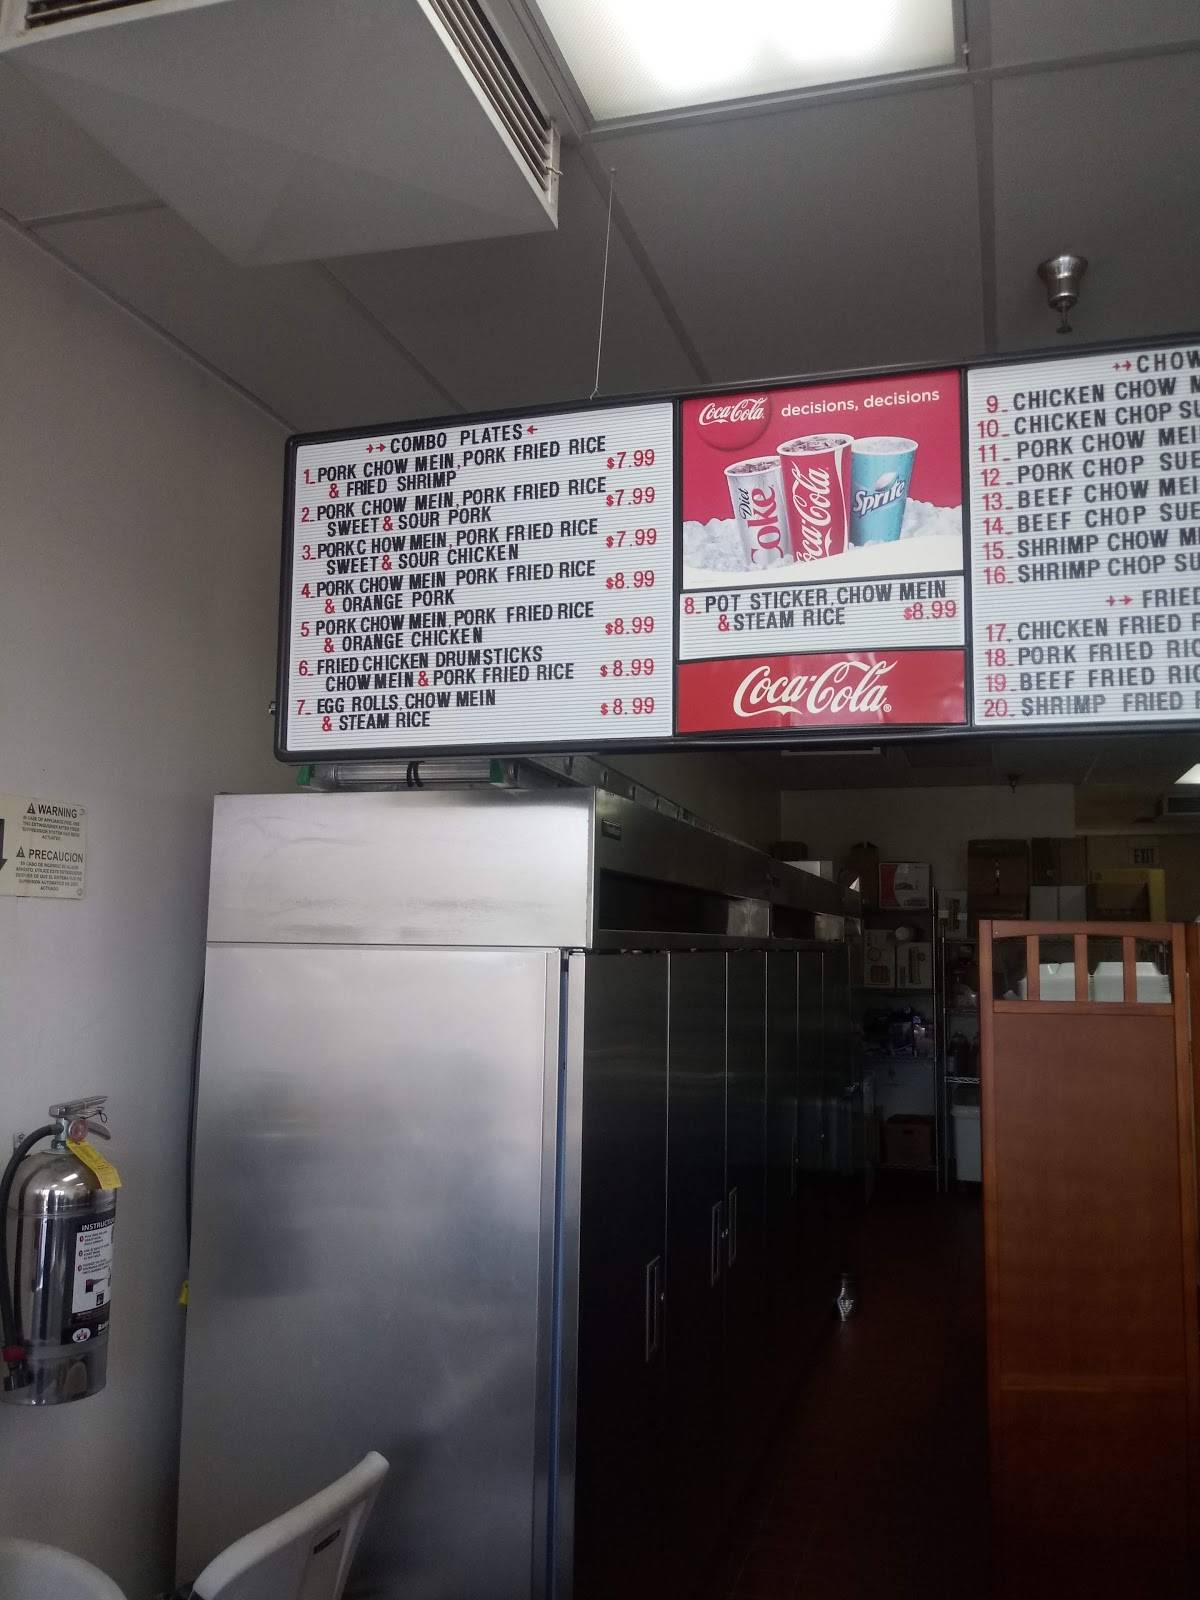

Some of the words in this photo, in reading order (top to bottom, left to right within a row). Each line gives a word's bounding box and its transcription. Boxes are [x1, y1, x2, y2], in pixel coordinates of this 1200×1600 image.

[781, 398, 859, 417] decisions,
[863, 390, 940, 409] decisions
[1013, 384, 1104, 411] CHICKEN
[1115, 377, 1177, 400] CHOW
[1014, 409, 1106, 435] CHICKEN
[1115, 402, 1172, 425] CHOP
[390, 432, 447, 453] COMBO
[460, 423, 523, 445] PLATES
[1017, 436, 1073, 459] PORK
[1082, 430, 1145, 453] CHOW
[318, 464, 357, 482] PORK
[364, 458, 408, 477] CHOW
[514, 440, 560, 462] FRIED
[569, 435, 606, 455] RICE
[607, 449, 655, 469] $7.99
[1017, 461, 1074, 483] PORK
[1082, 455, 1144, 479] CHOP
[328, 483, 339, 498] &
[347, 478, 387, 497] FRIED
[397, 470, 457, 492] SHRIMP
[606, 487, 655, 507] $7.99
[853, 478, 906, 514] Sprite
[1018, 487, 1073, 509] BEEF
[1084, 479, 1149, 503] CHOW
[317, 502, 355, 521] PORK
[362, 497, 406, 516] CHOW
[514, 481, 560, 501] FRIED
[568, 476, 606, 496] RICE
[738, 487, 752, 520] Diet
[327, 517, 380, 537] SWEET
[382, 515, 393, 531] &
[398, 511, 440, 530] SOUR
[449, 506, 492, 525] PORK
[506, 522, 553, 542] FRIED
[561, 518, 598, 537] RICE
[1017, 511, 1071, 534] BEEF
[1085, 505, 1146, 528] CHOP
[1017, 534, 1099, 558] SHRIMP
[1107, 529, 1169, 551] CHOW
[327, 556, 379, 575] SWEET
[381, 554, 392, 570] &
[398, 550, 439, 569] SOUR
[447, 543, 519, 565] CHICKEN
[1018, 559, 1101, 583] SHRIMP
[1107, 554, 1166, 576] CHOP
[316, 579, 354, 598] PORK
[360, 575, 406, 594] CHOW
[456, 567, 498, 586] PORK
[507, 563, 553, 582] FRIED
[559, 560, 596, 578] RICE
[605, 570, 655, 589] $8.99
[324, 599, 335, 614] &
[342, 593, 403, 613] ORANGE
[412, 589, 455, 607] PORK
[705, 594, 741, 613] POT
[899, 580, 946, 601] MEIN
[903, 600, 957, 620] $8.99
[316, 617, 357, 636] PORK
[360, 614, 405, 632] CHOW
[506, 604, 553, 623] FRIED
[558, 601, 594, 620] RICE
[605, 616, 654, 635] $8.99
[717, 614, 730, 631] &
[734, 611, 794, 631] STEAM
[803, 607, 845, 627] RICE
[1017, 618, 1108, 640] CHICKEN
[1119, 613, 1182, 636] FRIED
[324, 637, 334, 653] &
[342, 633, 404, 651] ORANGE
[411, 627, 483, 647] CHICKEN
[1018, 645, 1077, 666] PORK
[1089, 640, 1153, 662] FRIED
[318, 657, 359, 675] FRIED
[362, 652, 429, 672] CHICKEN
[436, 645, 543, 668] DRUMSTICKS
[418, 671, 429, 687] &
[434, 668, 476, 686] PORK
[483, 665, 530, 683] FRIED
[537, 663, 574, 681] RICE
[1020, 670, 1075, 691] BEEF
[1088, 666, 1155, 688] FRIED
[317, 697, 344, 714] EGG
[456, 689, 496, 707] MEIN
[1021, 694, 1106, 717] SHRIMP
[1122, 690, 1184, 713] FRIED
[322, 715, 332, 732] &
[339, 713, 390, 731] STEAM
[396, 711, 431, 728] RICE
[38, 804, 78, 819] WARNING
